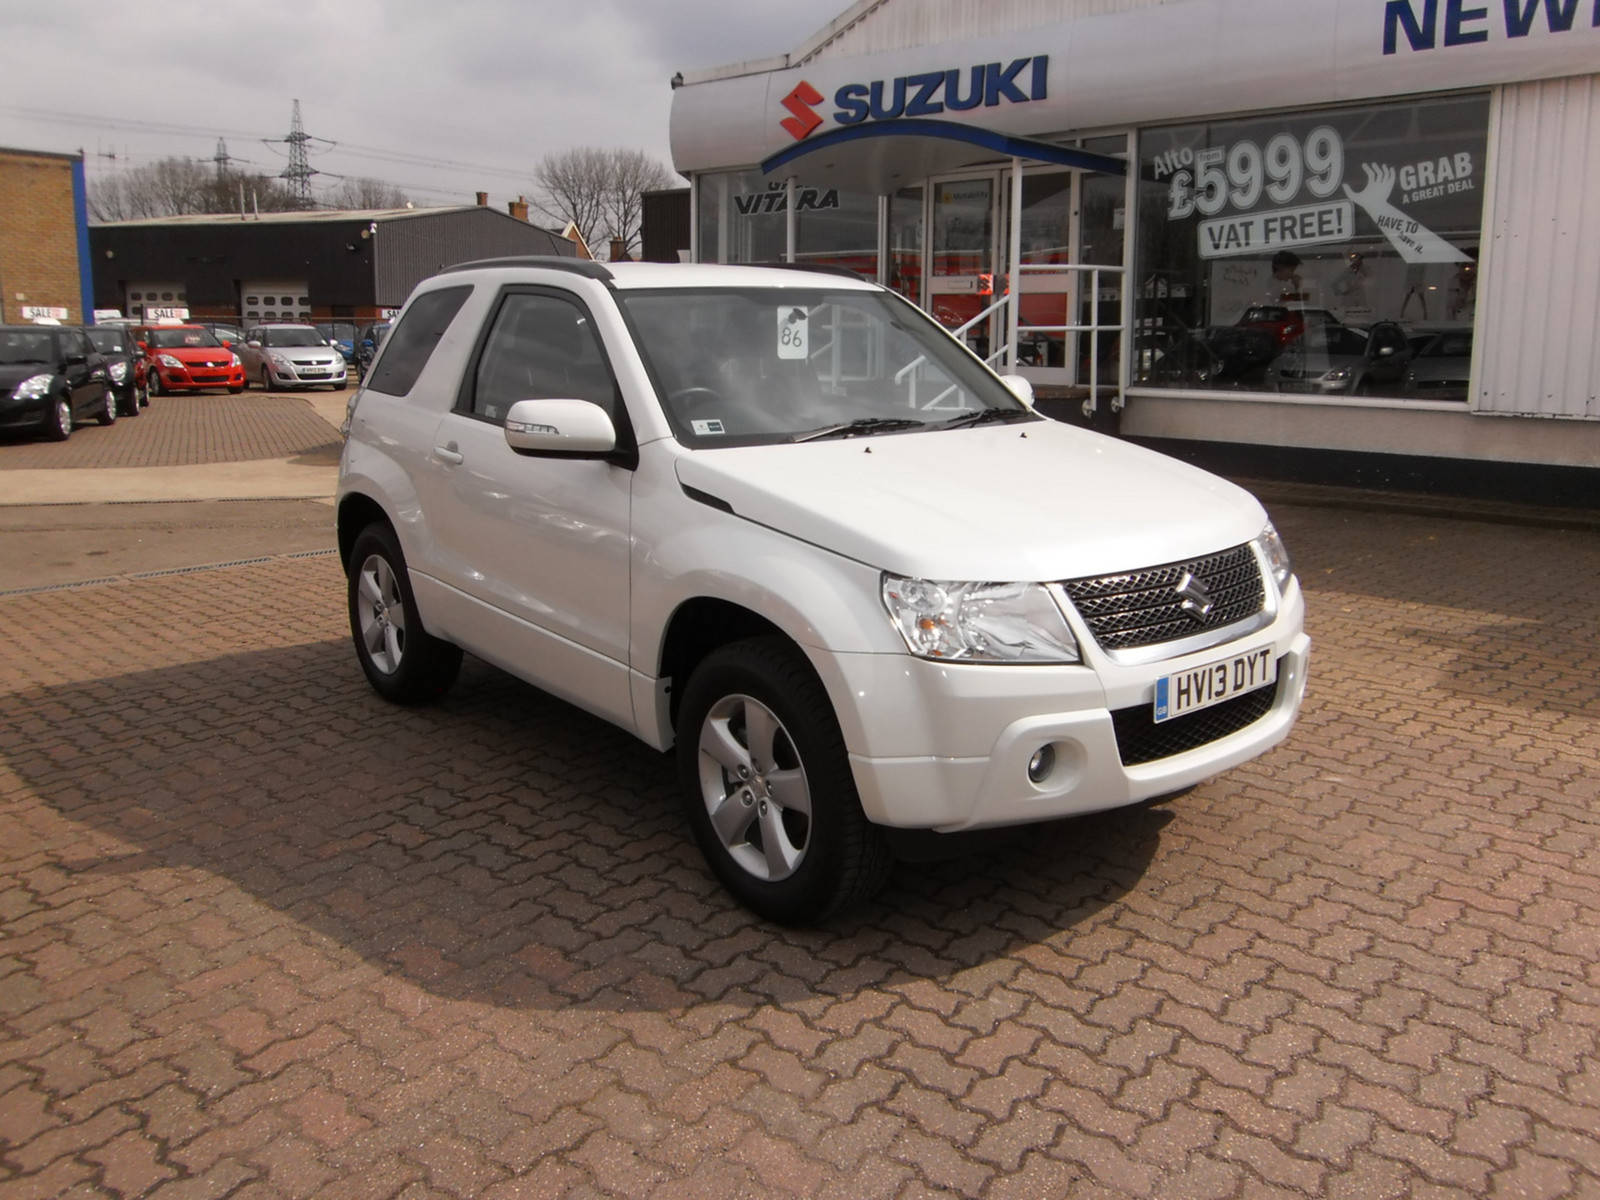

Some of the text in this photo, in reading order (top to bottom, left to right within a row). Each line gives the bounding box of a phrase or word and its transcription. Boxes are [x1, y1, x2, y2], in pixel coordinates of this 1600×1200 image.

[1382, 0, 1600, 55] NEW
[833, 54, 1049, 125] SUZUKI
[1153, 147, 1194, 180] Alto
[1167, 125, 1345, 221] £5999
[1399, 152, 1473, 191] GRAB
[1402, 179, 1475, 204] A GREAT DEAL
[1208, 207, 1343, 250] VAT FREE!
[1377, 215, 1419, 234] HAVE TO
[29, 308, 51, 318] SALE
[154, 308, 175, 318] SALE
[782, 326, 802, 347] 86
[1177, 648, 1270, 711] HV13 DYT
